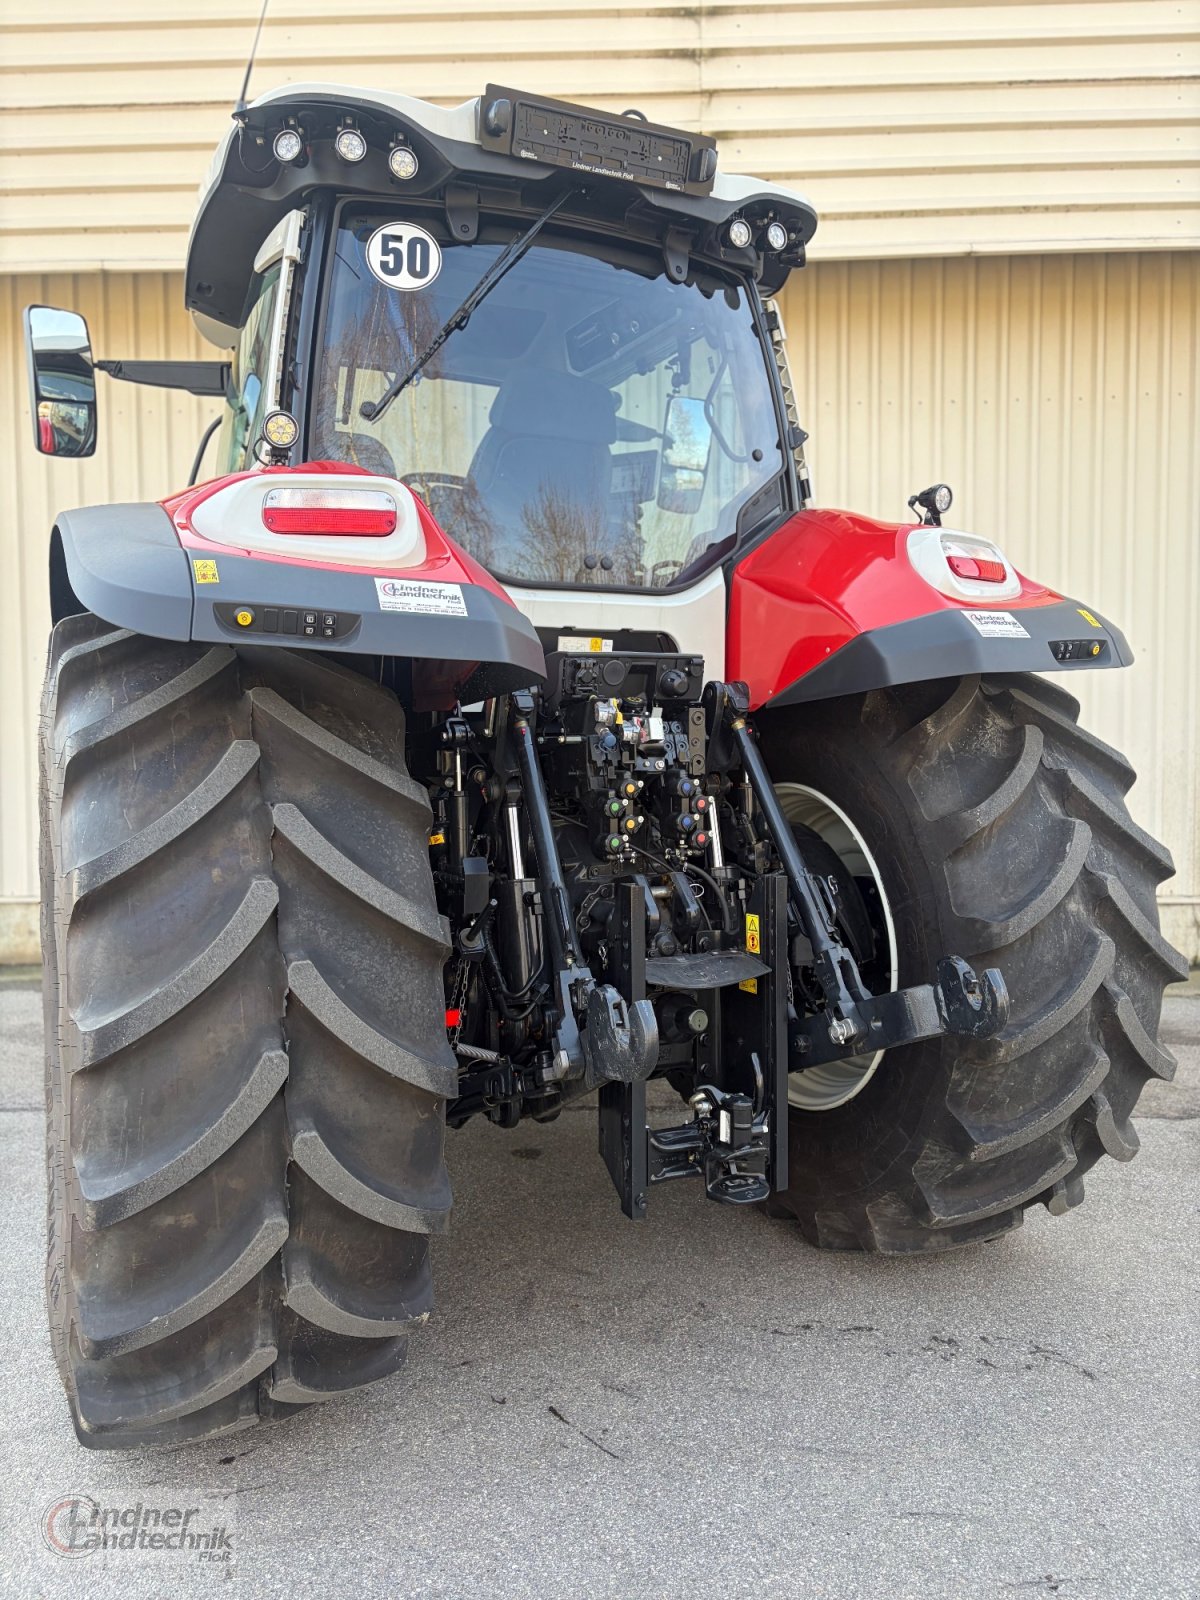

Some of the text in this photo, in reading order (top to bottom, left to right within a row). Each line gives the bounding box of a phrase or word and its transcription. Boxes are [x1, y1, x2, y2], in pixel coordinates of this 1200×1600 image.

[572, 161, 592, 170] Lindner
[592, 166, 622, 178] Landtechnik
[380, 233, 430, 279] 50
[391, 582, 445, 593] Lindner
[392, 588, 461, 600] Landtechnik
